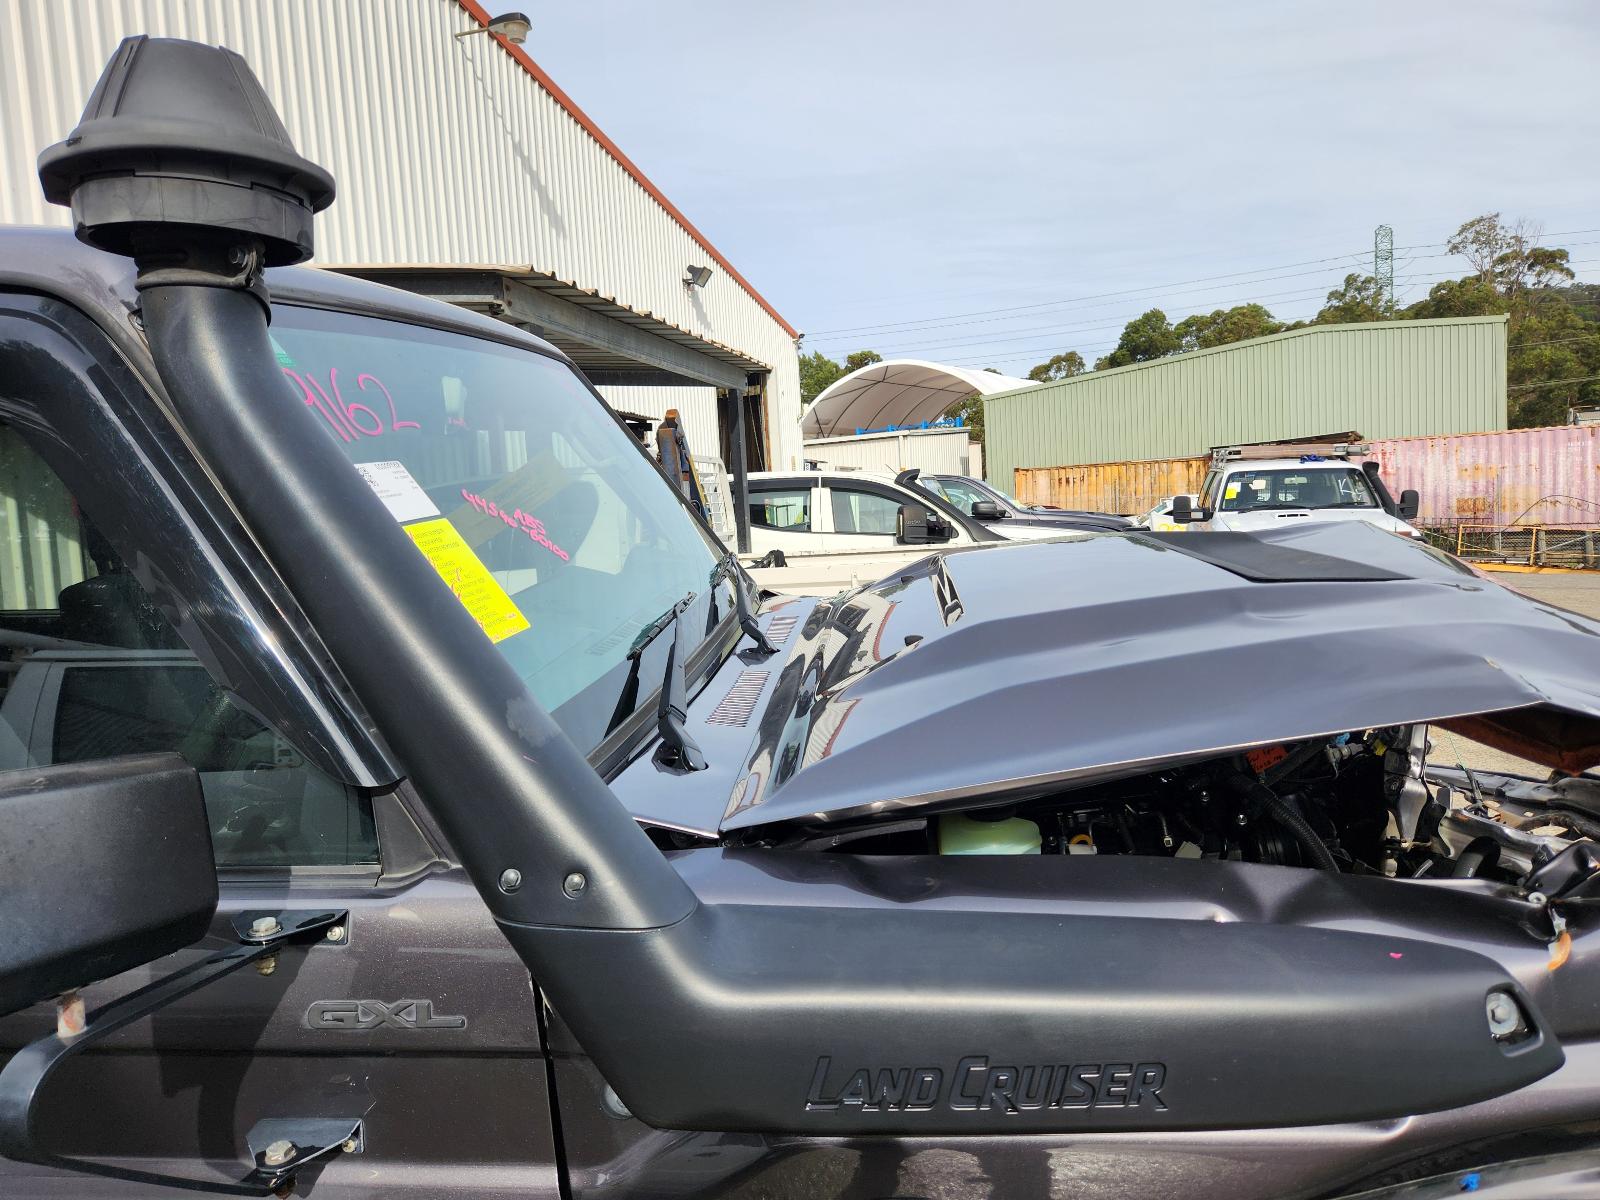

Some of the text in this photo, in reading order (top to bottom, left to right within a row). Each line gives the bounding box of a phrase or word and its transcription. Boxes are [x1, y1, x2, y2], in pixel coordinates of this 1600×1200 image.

[306, 1000, 467, 1030] GXL
[805, 1055, 1169, 1115] LAND CRUISER
